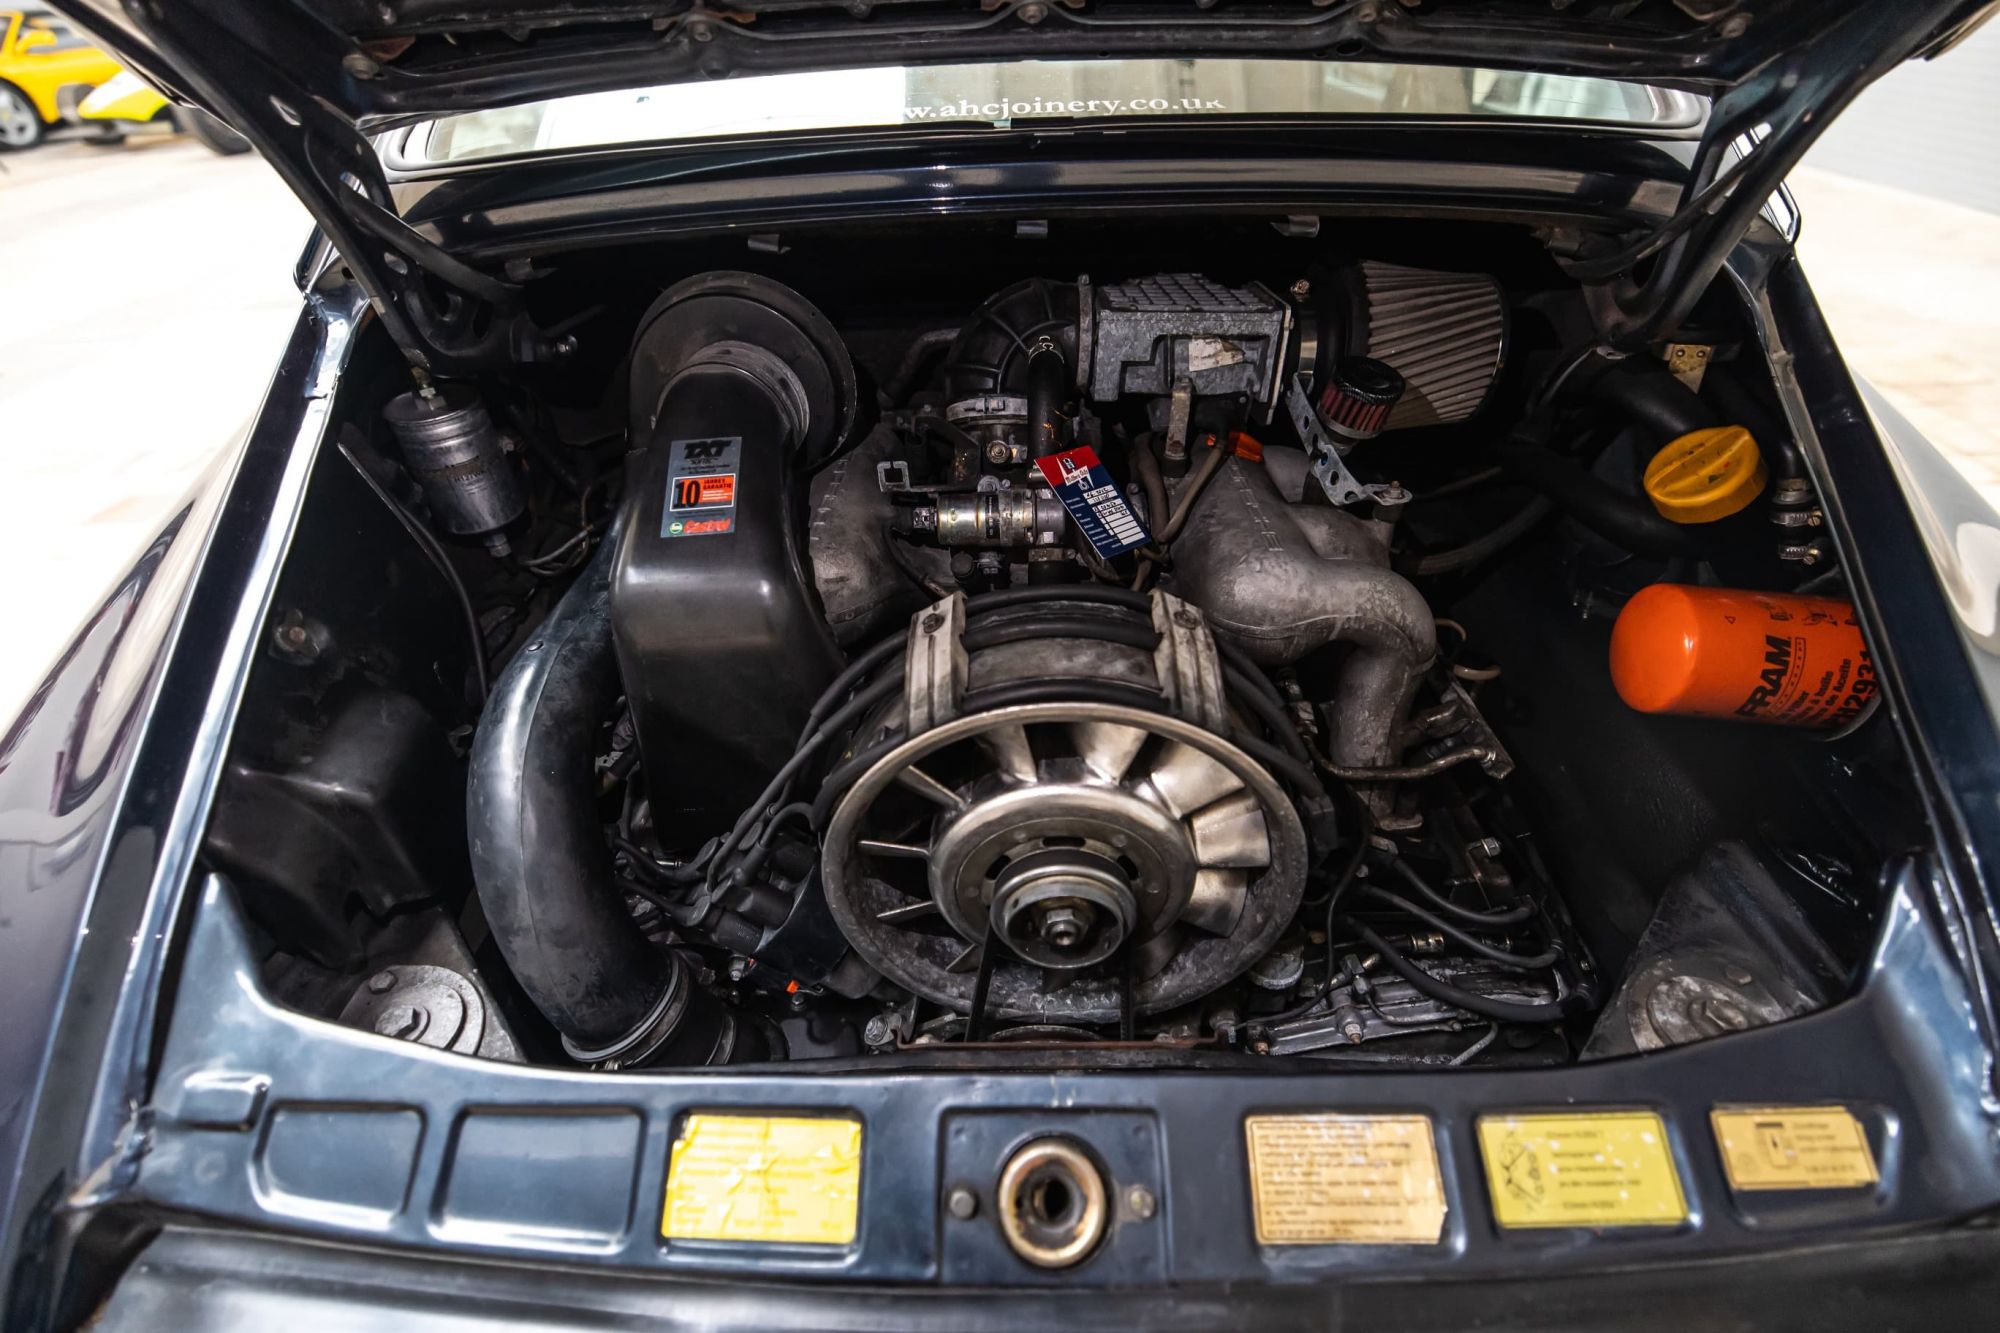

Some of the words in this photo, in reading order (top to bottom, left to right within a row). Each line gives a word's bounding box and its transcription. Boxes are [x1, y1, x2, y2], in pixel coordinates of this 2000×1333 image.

[673, 480, 701, 508] 10
[1734, 634, 1792, 717] FRAM
[1833, 658, 1852, 692] Aceite
